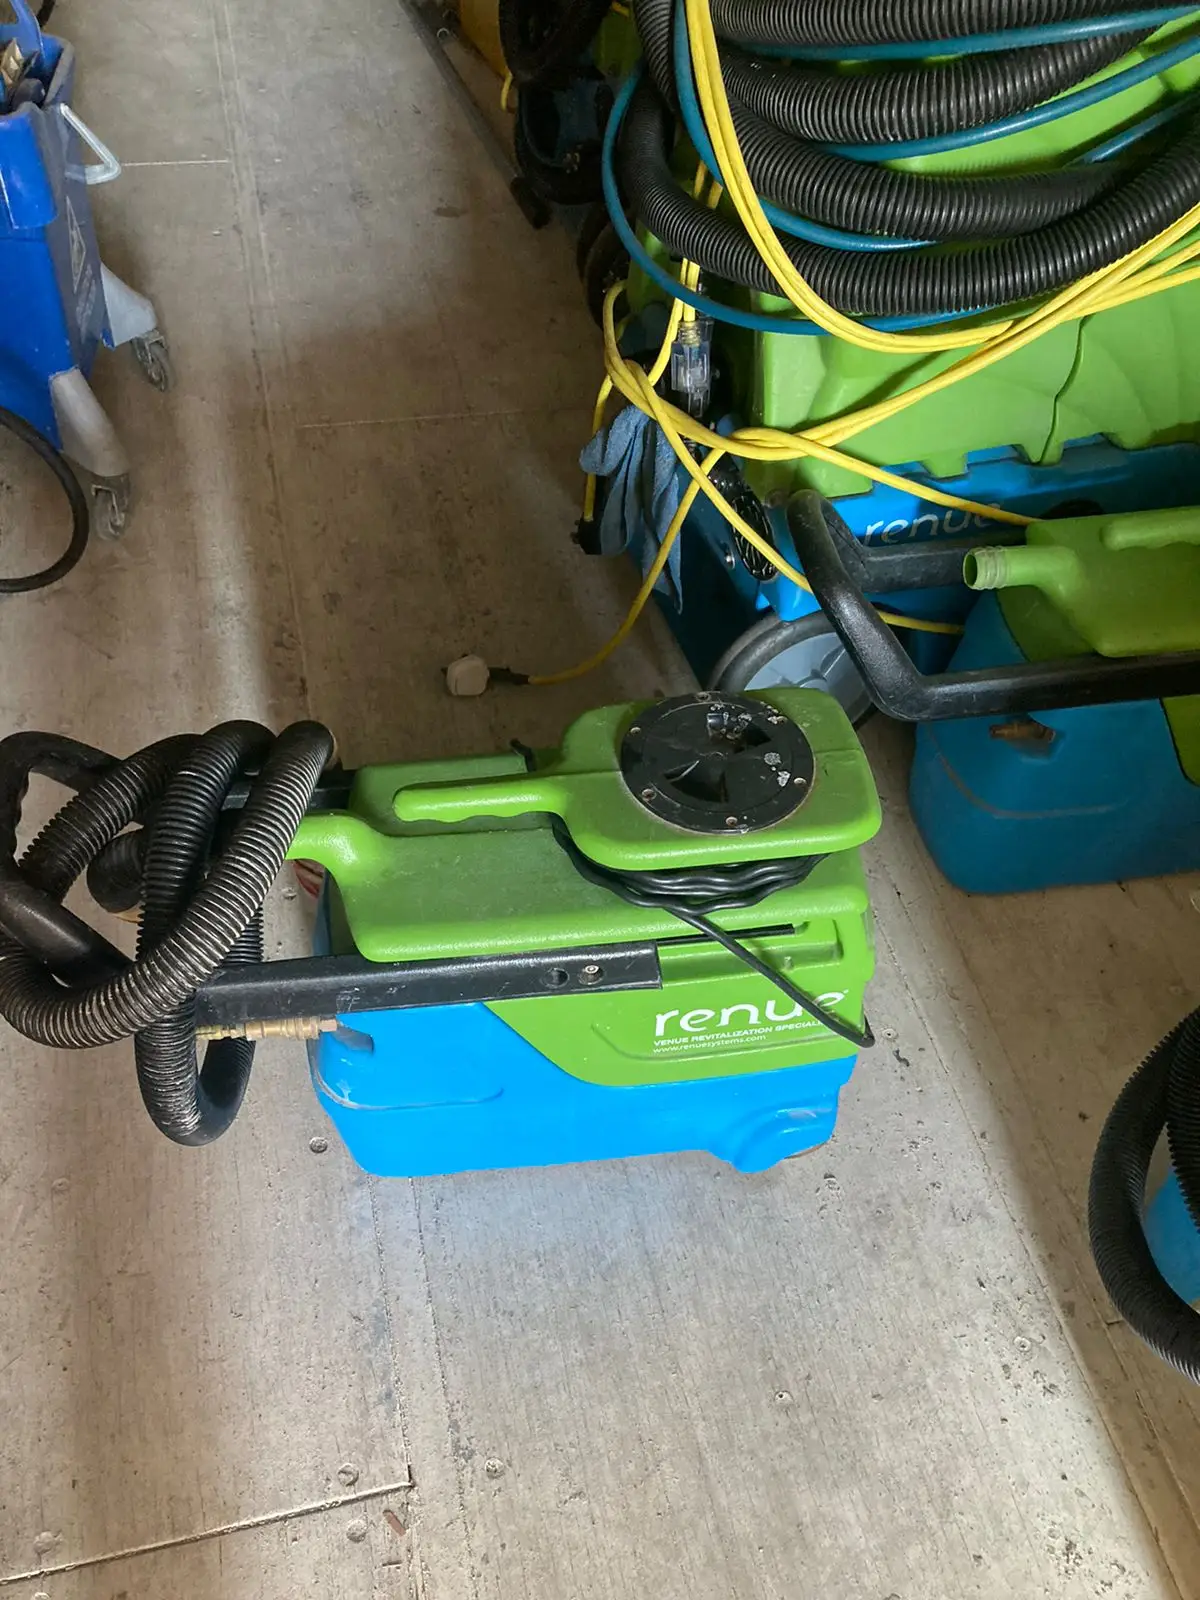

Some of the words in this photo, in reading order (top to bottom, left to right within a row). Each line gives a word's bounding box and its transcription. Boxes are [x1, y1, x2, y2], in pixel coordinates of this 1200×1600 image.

[653, 1037, 689, 1047] VENUE
[691, 1026, 772, 1042] REVITALIZATION
[775, 1020, 824, 1032] SPECIALI
[653, 1035, 766, 1053] www.renuesystems.com
